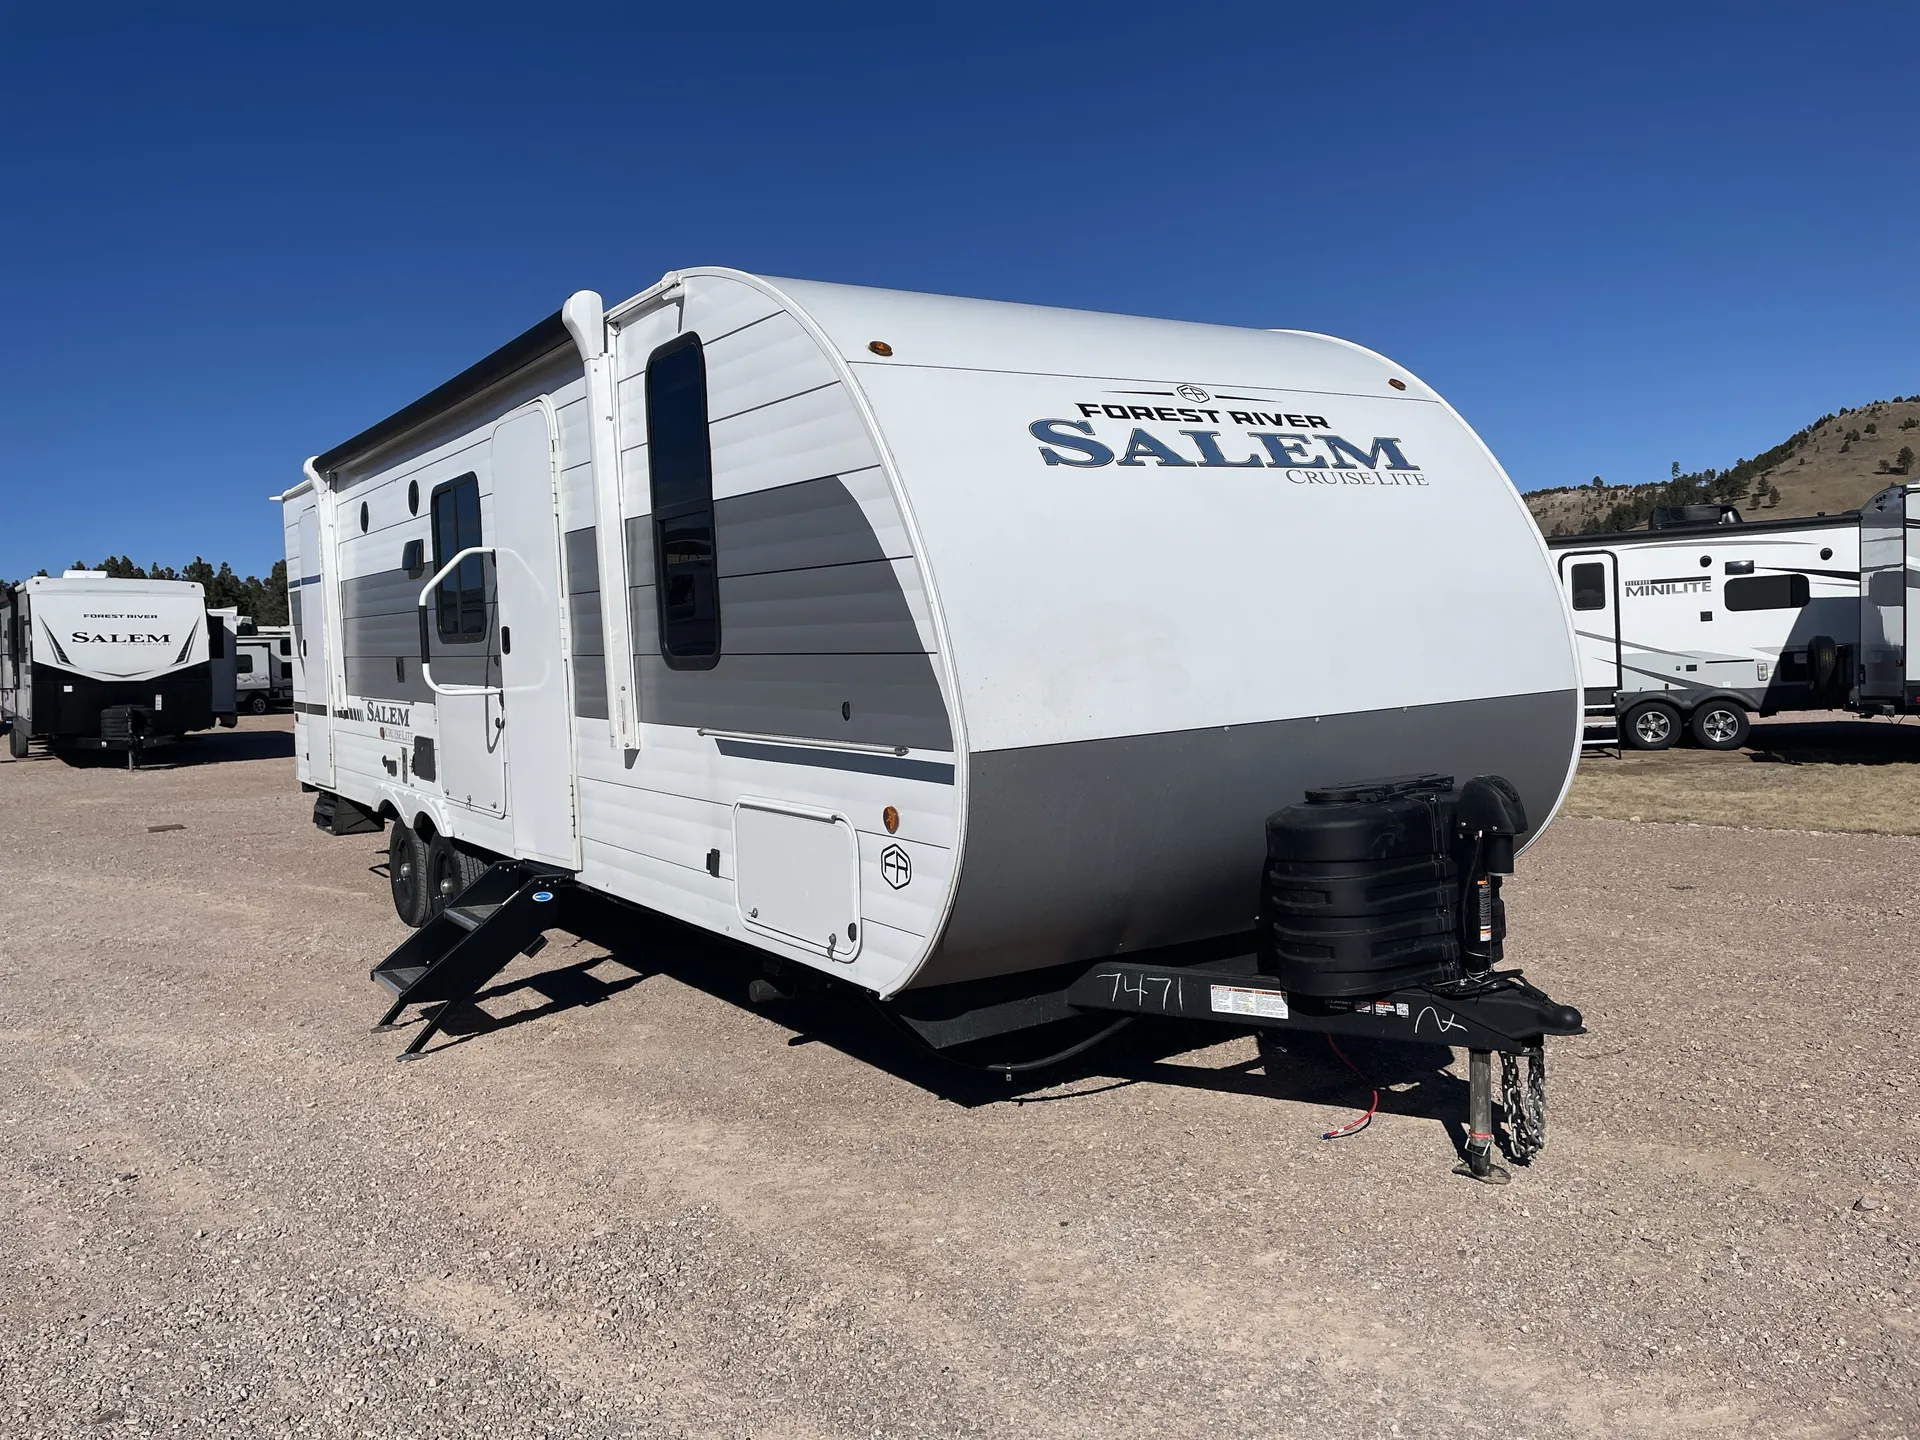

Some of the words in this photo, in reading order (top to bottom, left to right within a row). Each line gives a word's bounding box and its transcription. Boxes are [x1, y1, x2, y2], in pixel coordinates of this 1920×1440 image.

[1074, 402, 1220, 424] FOREST
[1226, 410, 1332, 429] RIVER
[1029, 417, 1420, 470] SALEM
[1626, 582, 1712, 597] MINILITE
[72, 632, 171, 643] SALEM
[367, 701, 410, 727] SALEM
[1096, 972, 1184, 1012] 7471
